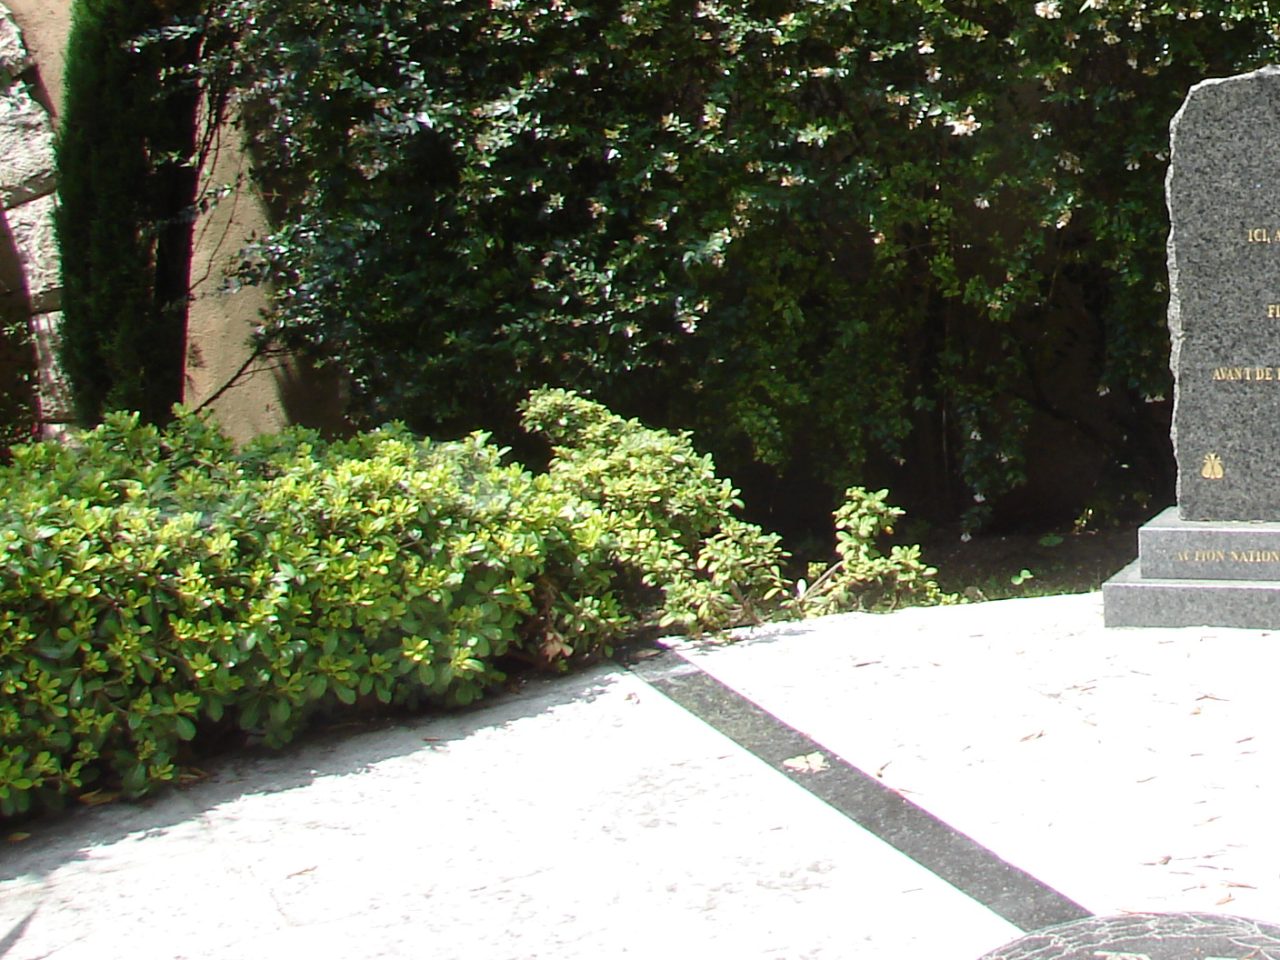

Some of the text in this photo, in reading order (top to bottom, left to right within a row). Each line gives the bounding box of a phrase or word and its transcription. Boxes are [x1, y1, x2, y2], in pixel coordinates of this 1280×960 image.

[1248, 228, 1270, 243] ICI,
[1212, 367, 1251, 380] AVANT
[1255, 367, 1273, 380] DE
